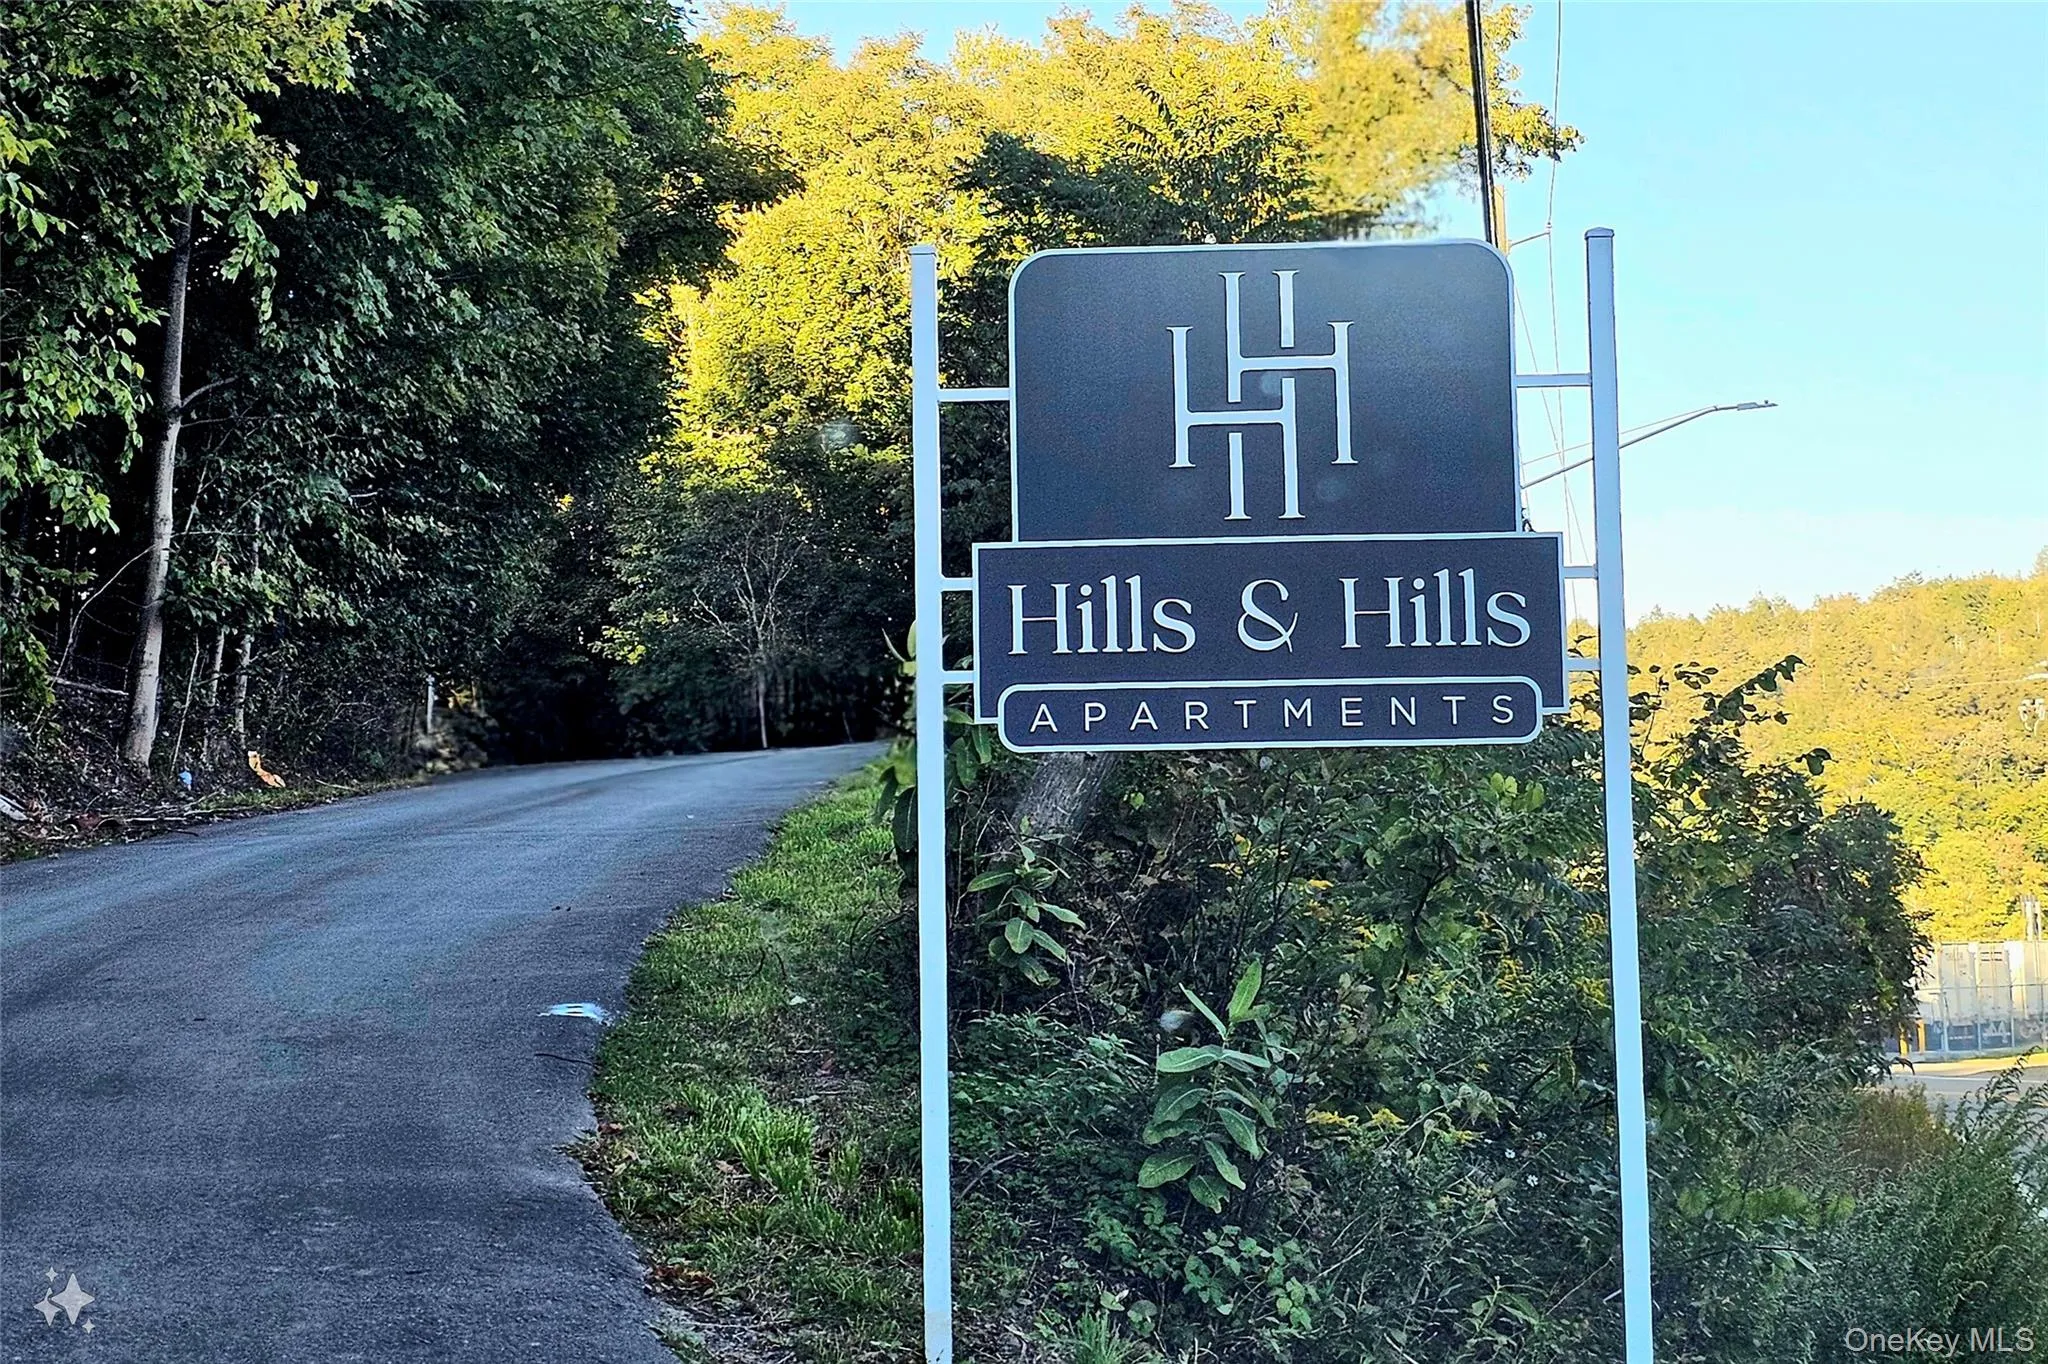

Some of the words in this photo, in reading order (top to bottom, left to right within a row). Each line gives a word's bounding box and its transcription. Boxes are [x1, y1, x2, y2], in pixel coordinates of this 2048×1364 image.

[1007, 575, 1197, 655] Hills
[1237, 579, 1299, 653] &
[1340, 568, 1531, 649] Hills
[1030, 695, 1515, 733] APARTMENTS
